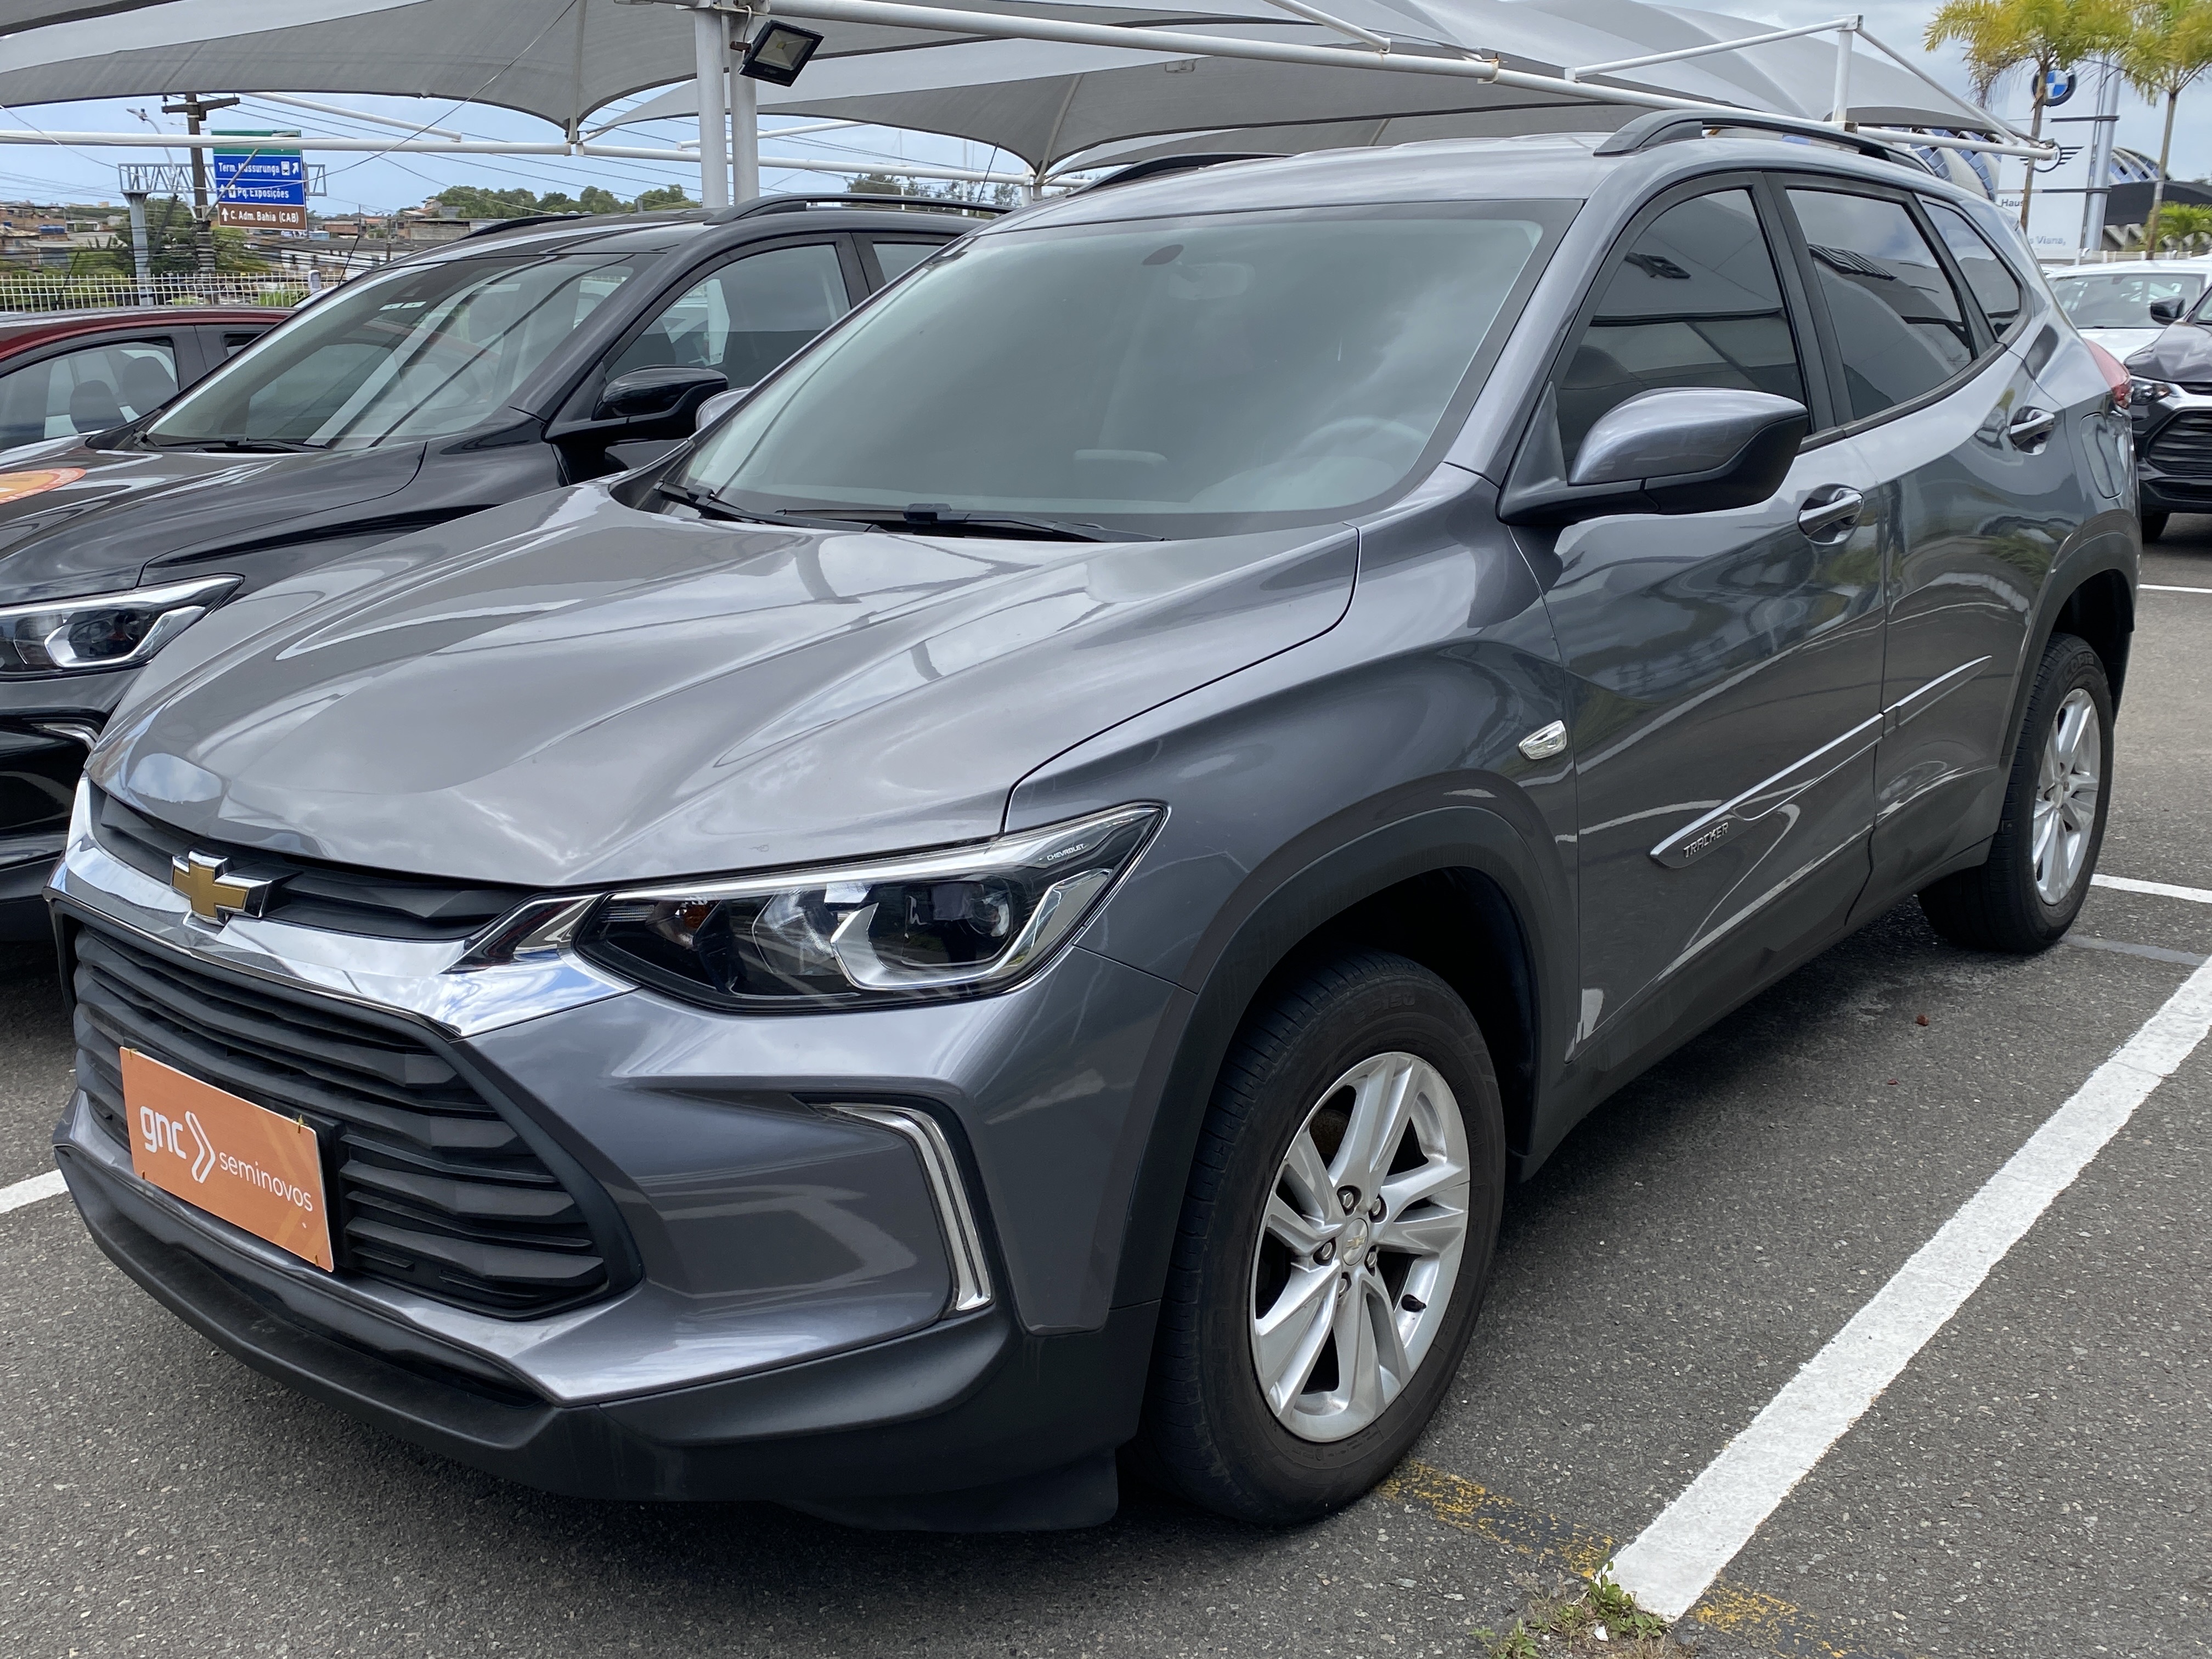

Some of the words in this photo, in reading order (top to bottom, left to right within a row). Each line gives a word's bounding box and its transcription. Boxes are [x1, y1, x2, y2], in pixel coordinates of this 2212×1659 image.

[218, 162, 238, 172] Term.
[237, 187, 249, 199] Pq.
[250, 188, 289, 199] Exposições
[230, 210, 238, 220] C.
[239, 211, 256, 221] Adm.
[256, 211, 276, 222] Bahia
[279, 211, 300, 224] (CAB)
[1683, 822, 1729, 858] TRACKER
[1046, 843, 1085, 861] CHEVROLET
[140, 1105, 187, 1160] gnc
[219, 1151, 313, 1212] seminovos
